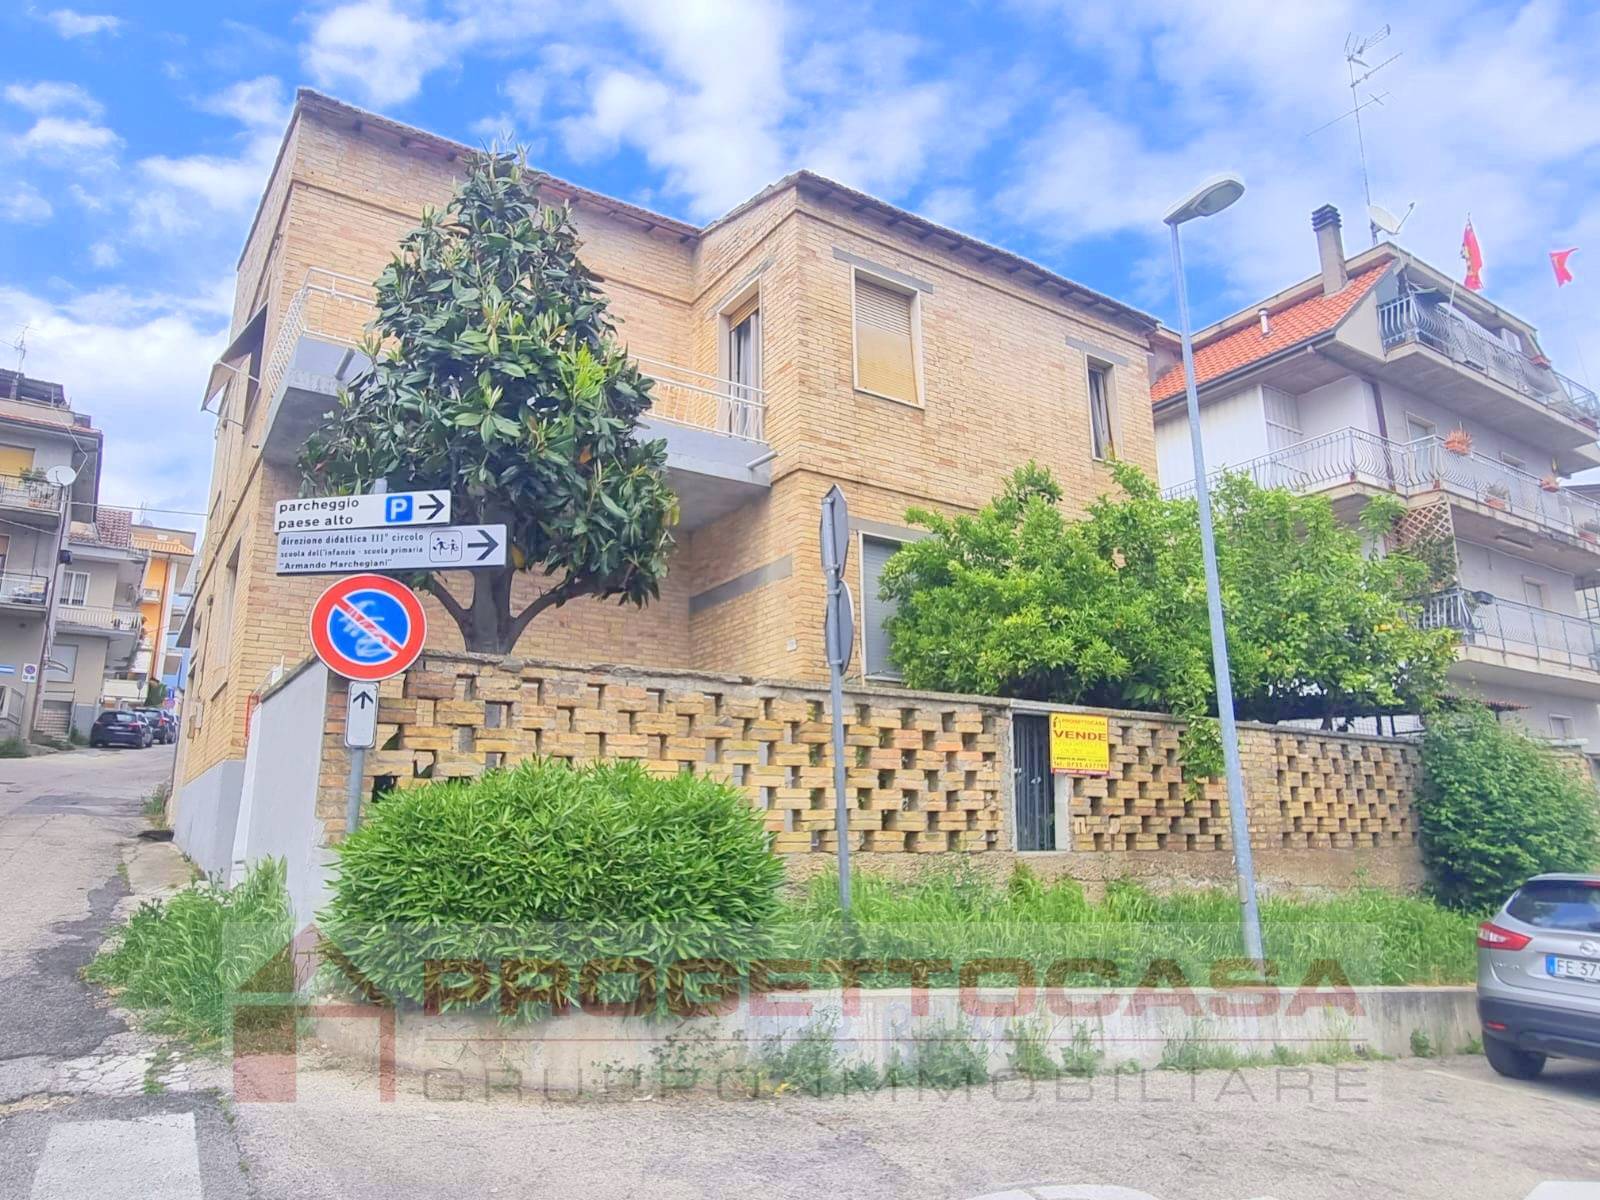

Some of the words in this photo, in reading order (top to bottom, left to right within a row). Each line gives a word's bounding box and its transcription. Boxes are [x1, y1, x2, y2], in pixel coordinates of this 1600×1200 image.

[279, 498, 360, 514] parcheggio
[390, 498, 408, 520] P
[278, 517, 320, 531] paese
[324, 515, 354, 526] alto
[281, 535, 323, 546] direzione
[325, 534, 368, 544] didattica
[391, 532, 424, 542] circolo
[363, 547, 388, 555] scuola
[390, 547, 423, 555] primaria
[1054, 730, 1107, 741] VENDE
